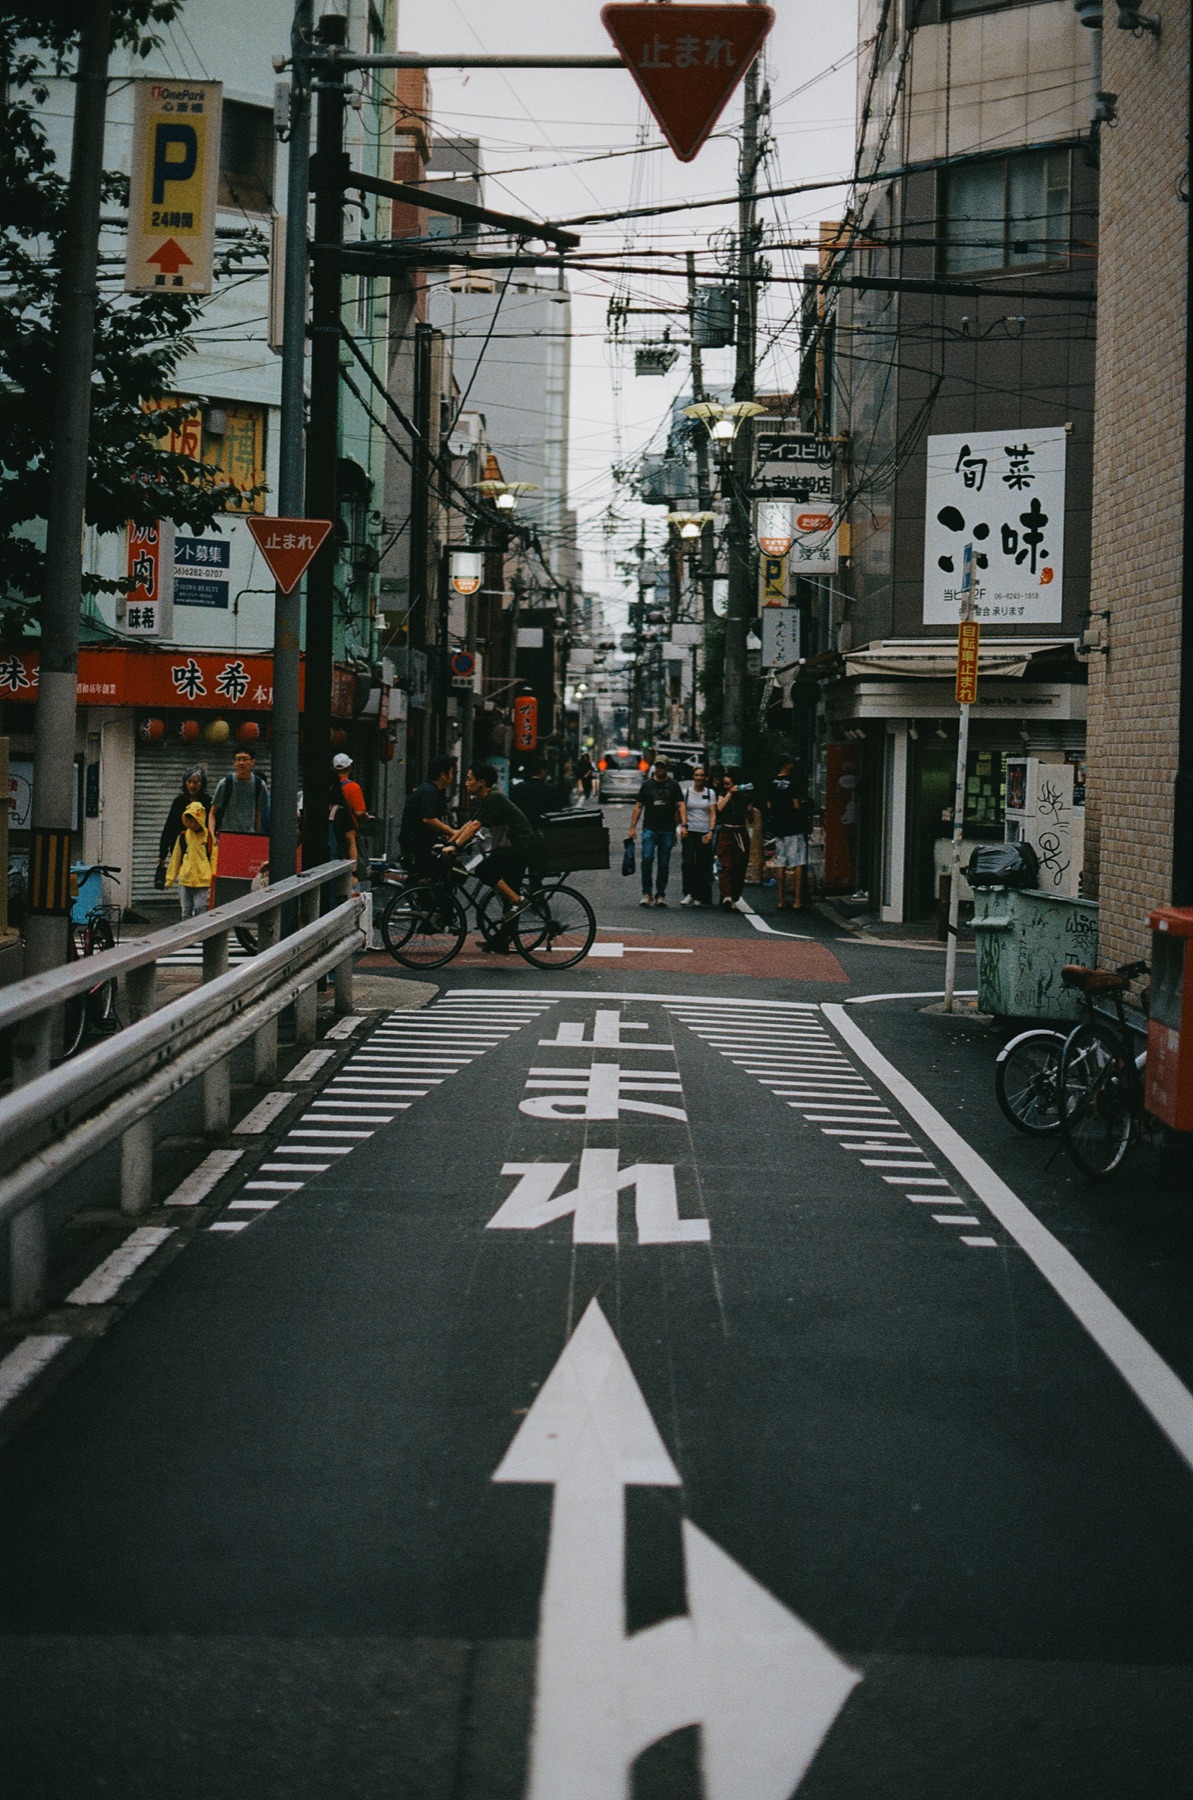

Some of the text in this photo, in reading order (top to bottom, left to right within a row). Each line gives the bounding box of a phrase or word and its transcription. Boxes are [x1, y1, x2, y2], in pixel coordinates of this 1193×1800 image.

[637, 33, 738, 69] 止まれ
[161, 88, 205, 101] OnePark
[152, 122, 198, 205] P
[151, 211, 193, 229] 24時間
[154, 273, 184, 287] 直進
[955, 443, 1036, 492] 旬菜
[264, 531, 315, 552] 止まれ
[765, 559, 782, 588] P
[128, 606, 155, 630] 味希
[958, 625, 976, 700] 自転車止まれ
[171, 657, 251, 704] 味希
[485, 1010, 711, 1245] 止まれ
